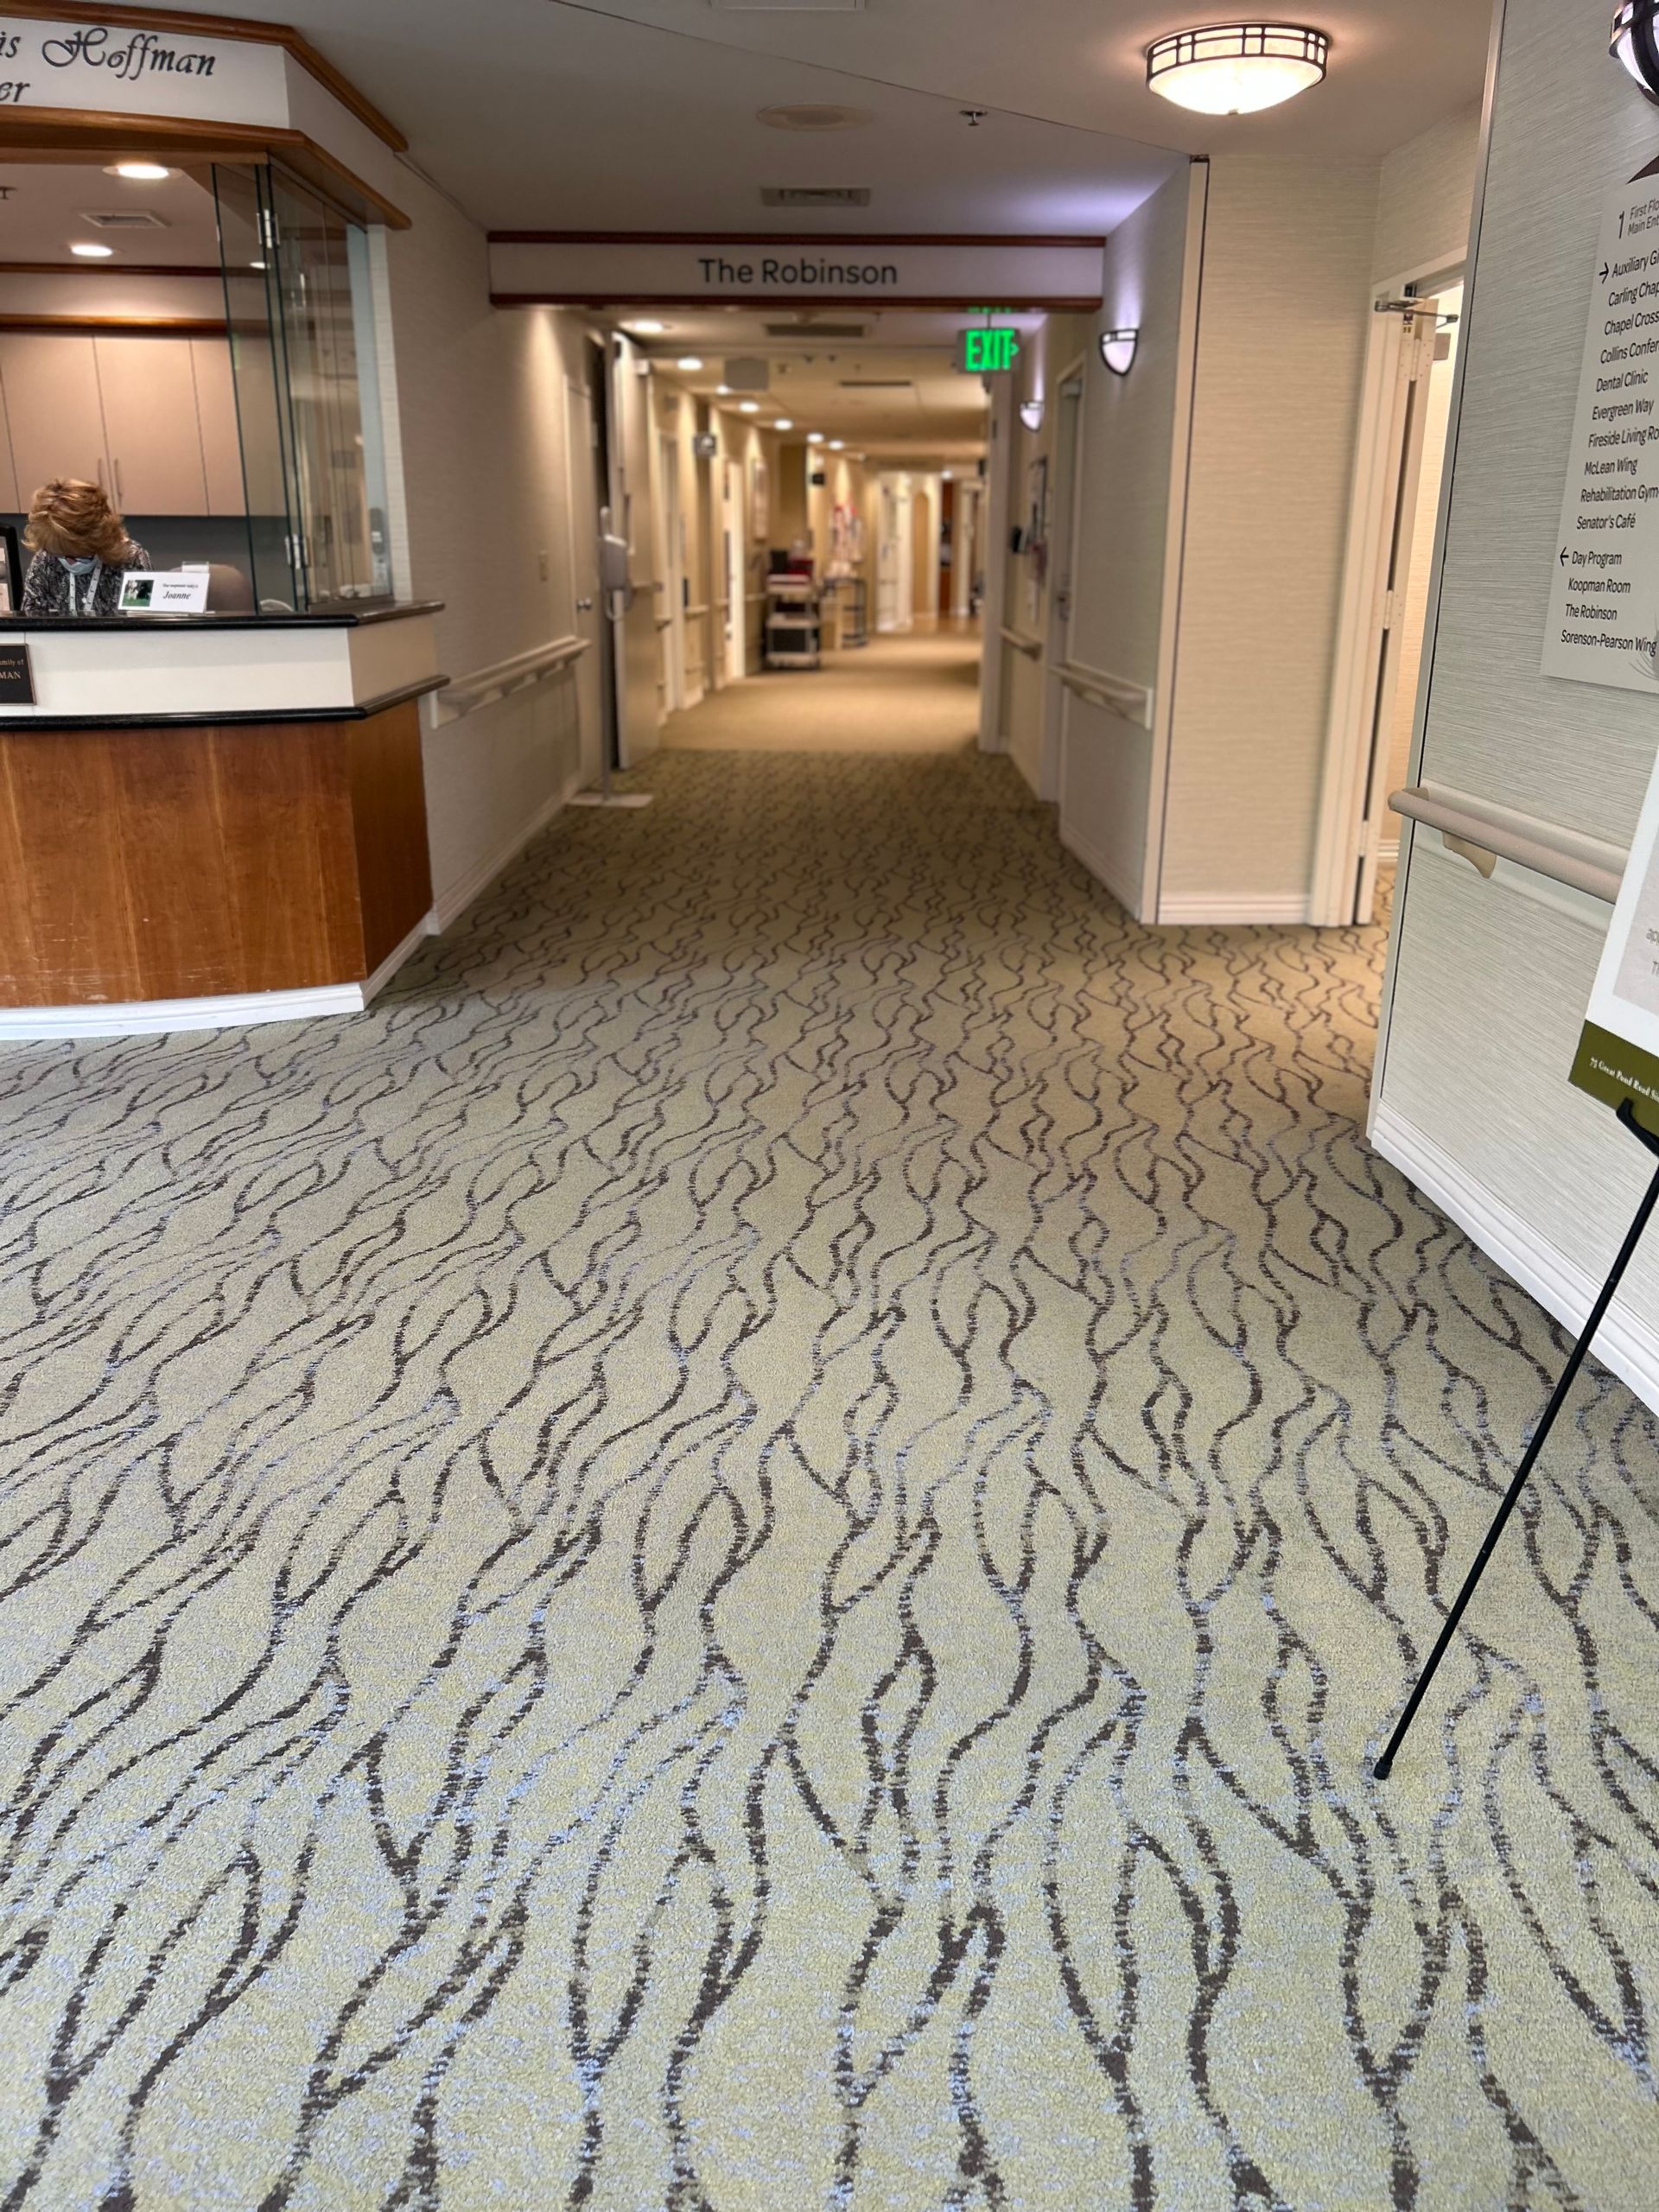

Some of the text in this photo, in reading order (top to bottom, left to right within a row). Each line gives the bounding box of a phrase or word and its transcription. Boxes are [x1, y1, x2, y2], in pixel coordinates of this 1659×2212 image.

[41, 28, 215, 80] Hoffman
[1630, 204, 1648, 220] First
[1628, 220, 1645, 236] Main
[698, 258, 898, 284] The Robinson
[1611, 256, 1649, 277] Auxiliary
[1608, 286, 1638, 306] Carling
[1605, 314, 1635, 335] Chapel
[966, 328, 1015, 372] EXIT
[1600, 346, 1628, 364] Collins
[1596, 368, 1649, 392] Dental Clinic
[1592, 398, 1655, 422] Evergreen Way
[1589, 430, 1621, 448] Fireside
[1621, 427, 1647, 446] Living
[1584, 457, 1638, 475] McLean Wing
[1580, 486, 1637, 502] Rehabilitation
[1576, 512, 1637, 530] Senator's Café
[1572, 550, 1622, 569] Day Program
[1568, 577, 1630, 594] Koopman Room
[162, 591, 191, 600] Joanne
[1566, 603, 1618, 620] The Robinson
[1560, 629, 1657, 657] Sorenson-Pearson Wing
